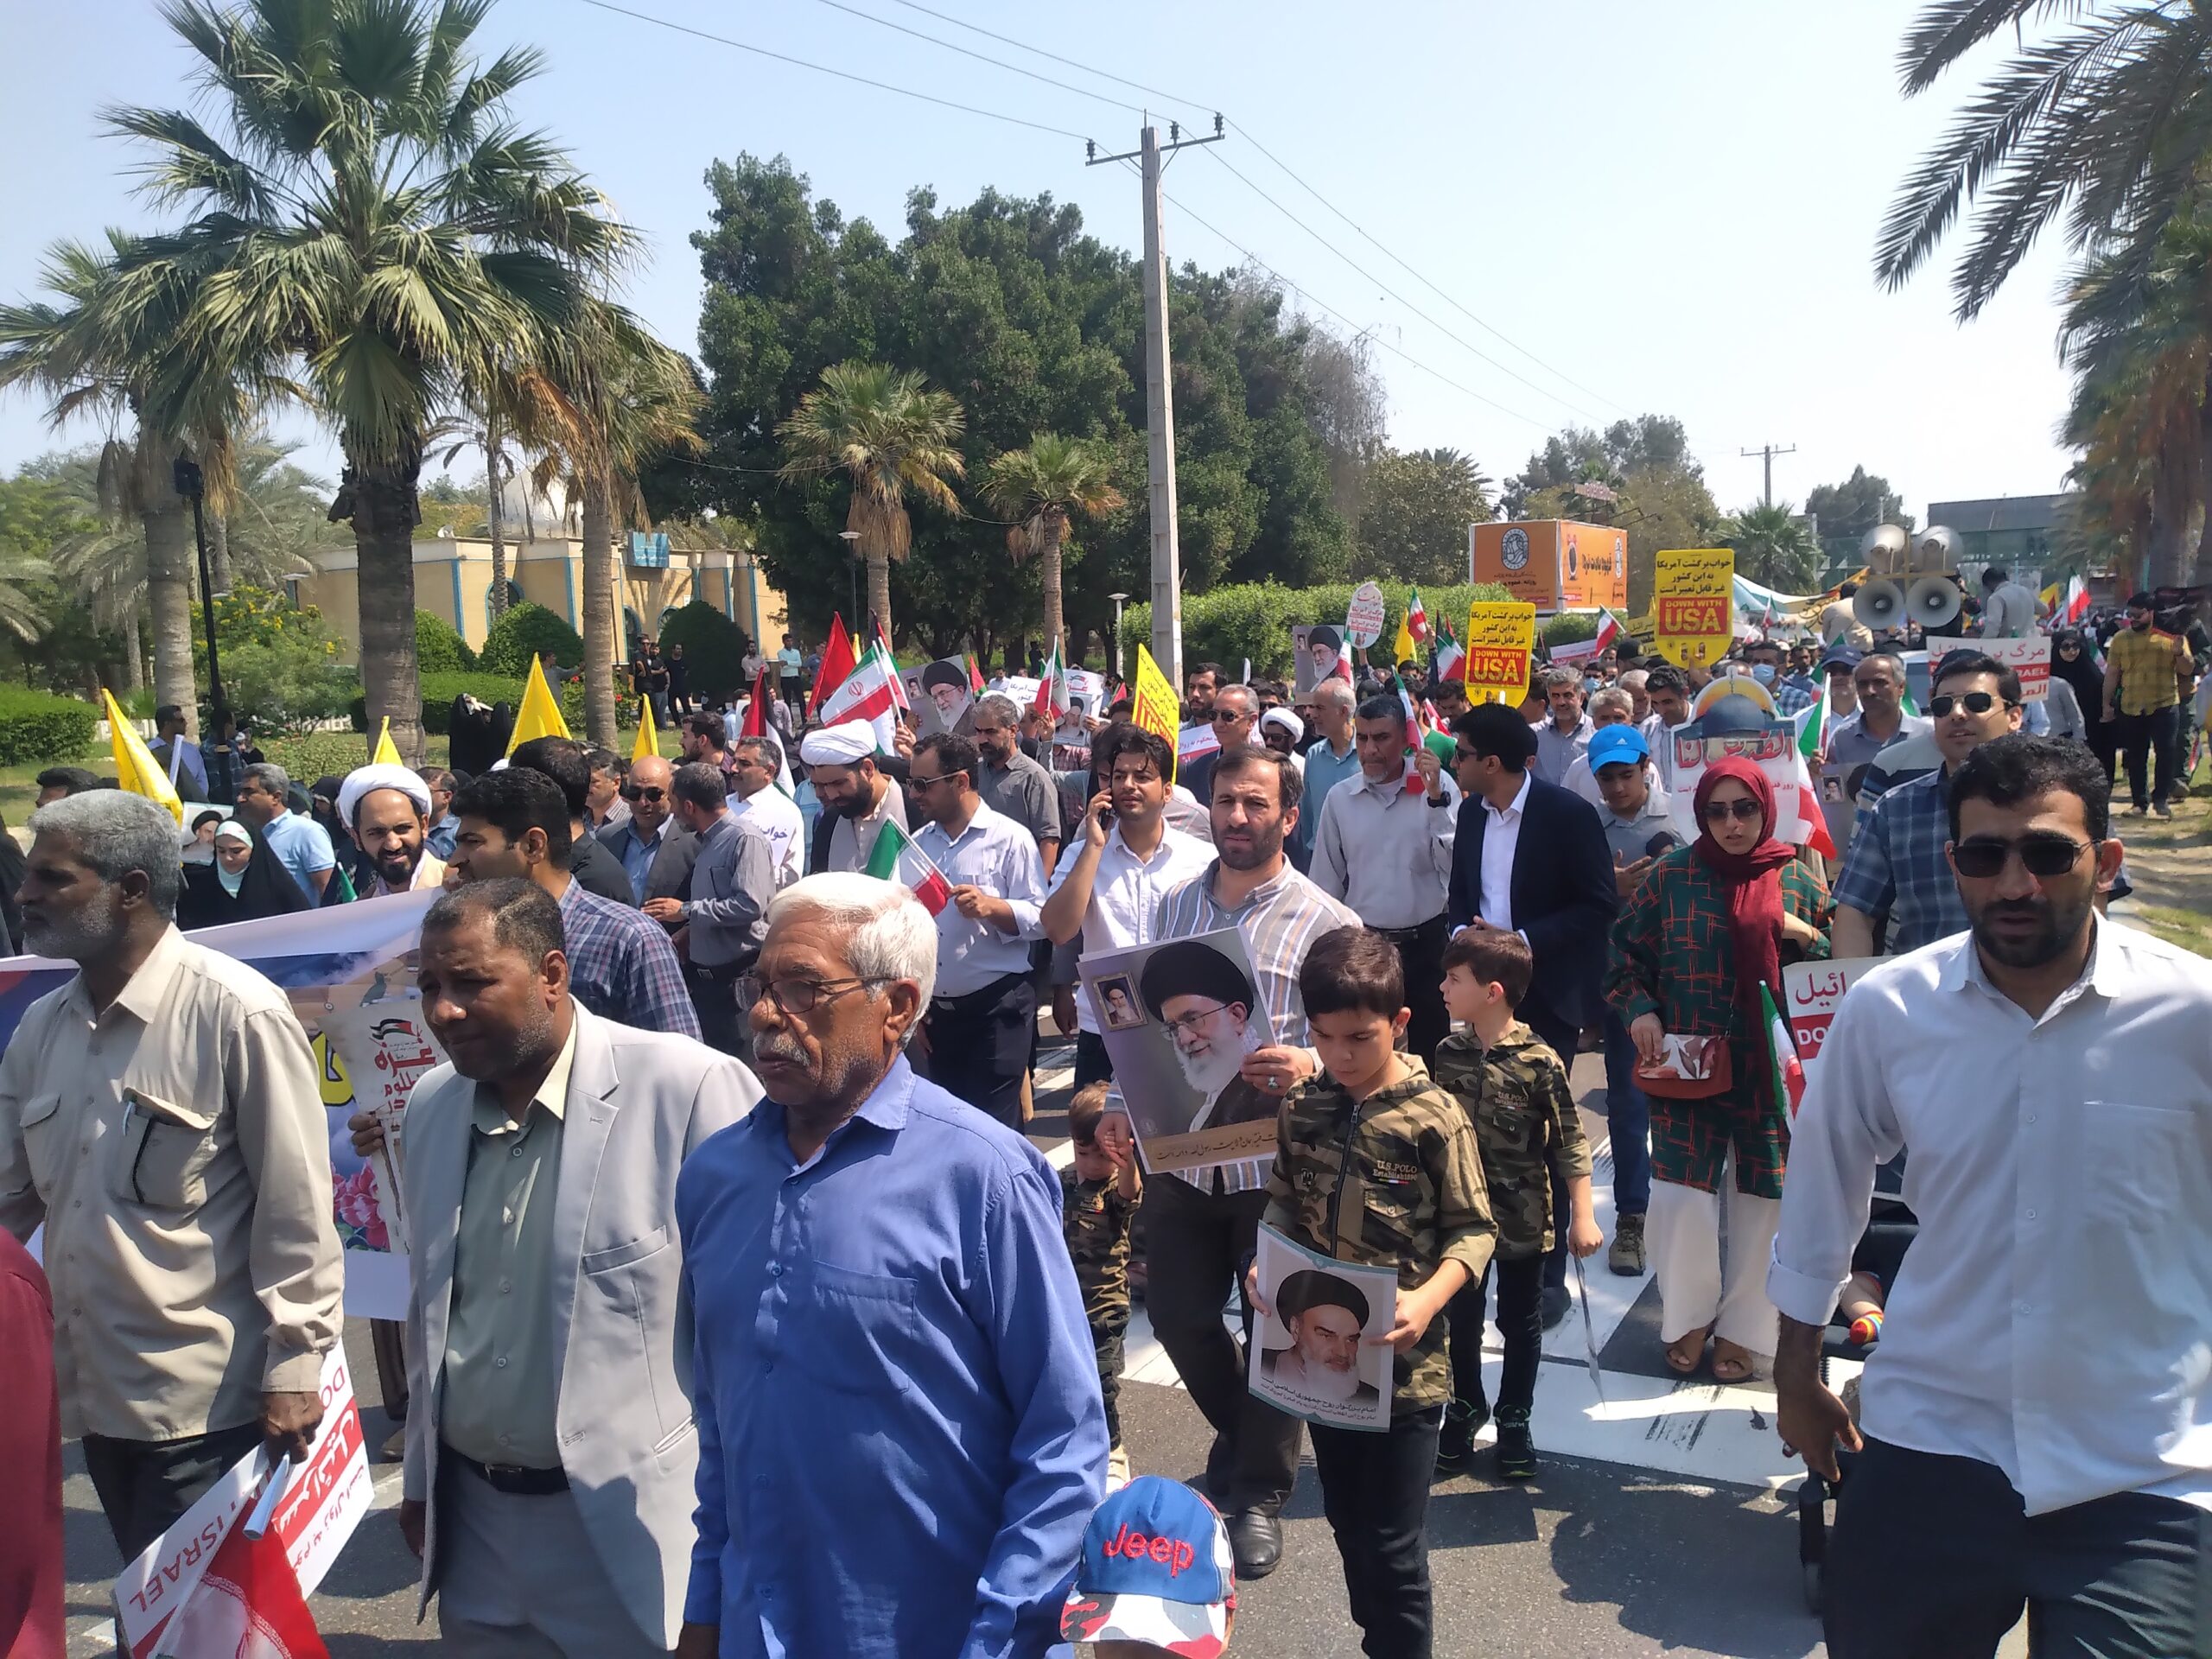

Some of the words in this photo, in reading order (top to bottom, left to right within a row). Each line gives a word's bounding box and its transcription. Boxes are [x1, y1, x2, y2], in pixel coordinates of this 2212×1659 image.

[1656, 559, 1681, 570] آمریکا
[1672, 572, 1691, 583] کشور
[1693, 572, 1706, 582] این
[1665, 600, 1694, 608] DOWN
[1697, 600, 1722, 608] WITH
[1471, 610, 1491, 621] آمریکا
[1665, 607, 1721, 632] USA
[1482, 624, 1498, 633] کشور
[1499, 624, 1510, 632] این
[2009, 643, 2045, 661] مرگ
[1474, 658, 1520, 683] USA
[2019, 667, 2048, 677] RAEL
[1141, 696, 1160, 724] DOWN
[1796, 970, 1847, 1007] ائیل
[1796, 1027, 1830, 1046] DO
[321, 1364, 346, 1410] DO
[1103, 1522, 1195, 1579] Jeep
[129, 1515, 224, 1614] ISRAEL
